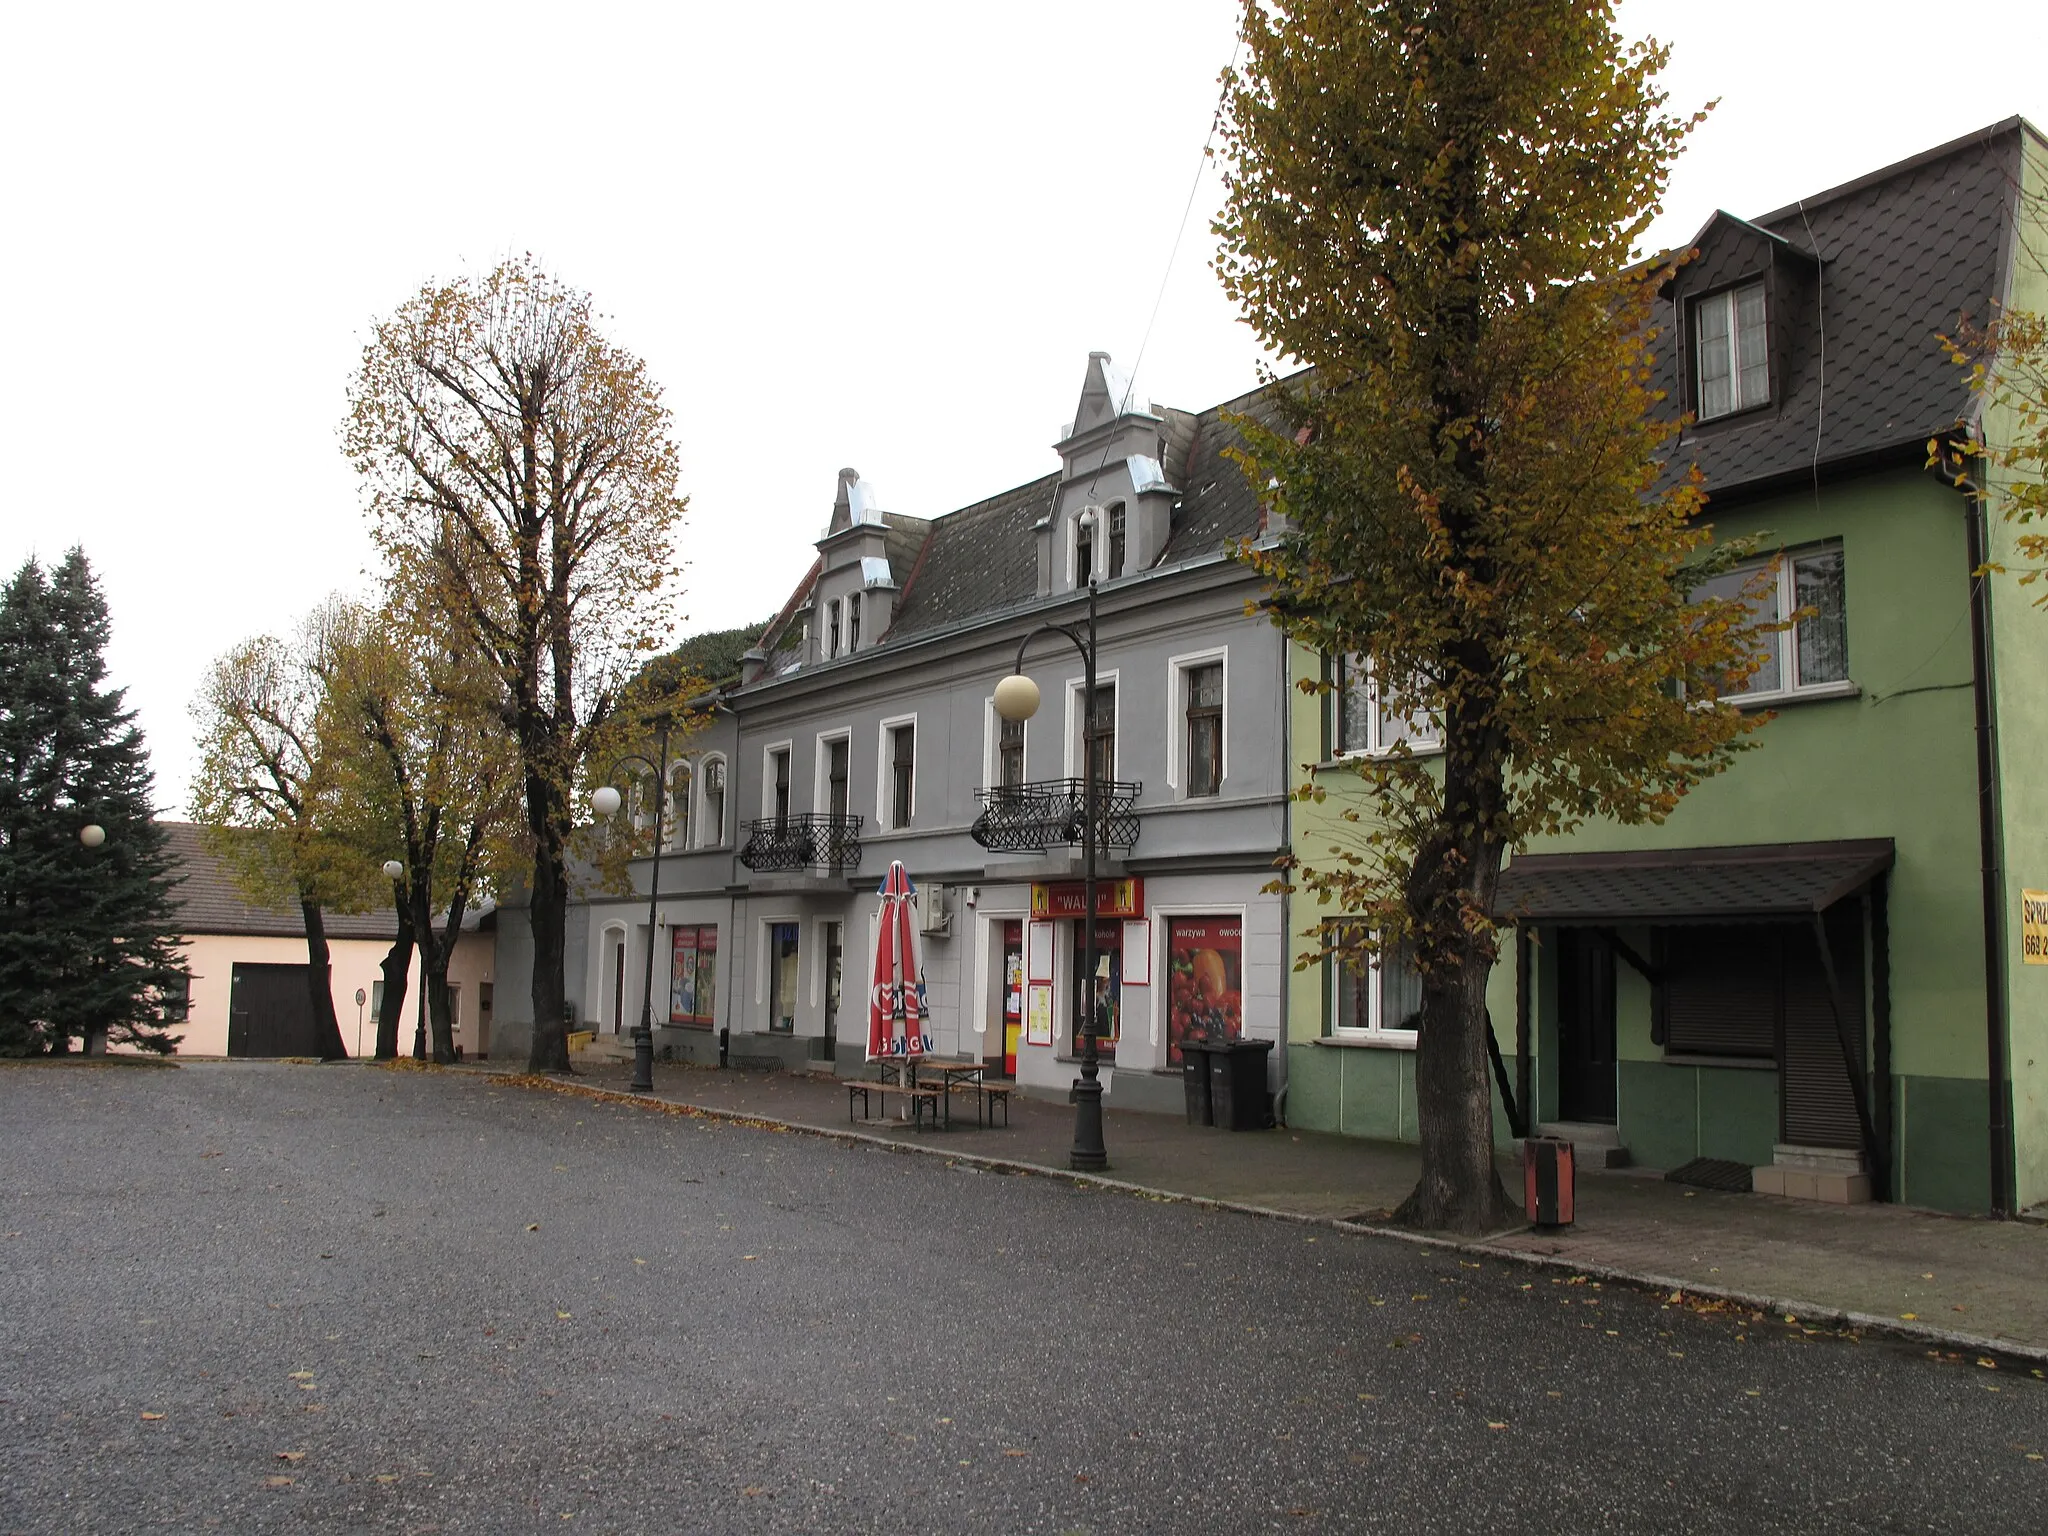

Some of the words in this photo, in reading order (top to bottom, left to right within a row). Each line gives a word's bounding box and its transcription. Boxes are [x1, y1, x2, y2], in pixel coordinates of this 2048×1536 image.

[1057, 893, 1107, 910] "WALI"
[2024, 899, 2048, 925] SPRZ
[1175, 928, 1206, 939] warzywa
[2025, 934, 2041, 956] 669
